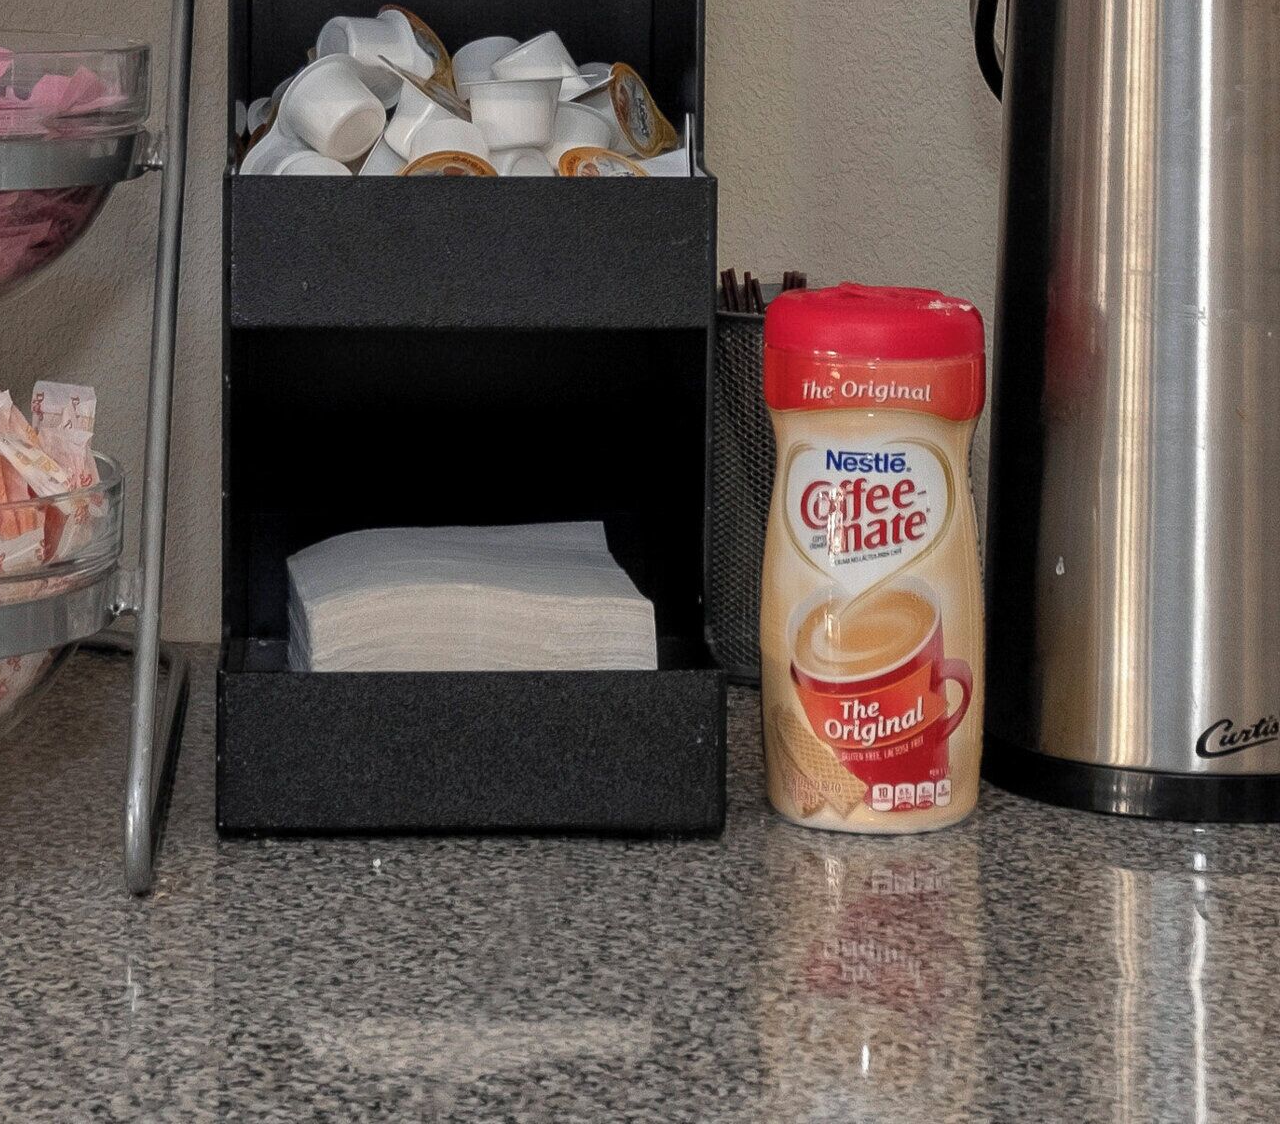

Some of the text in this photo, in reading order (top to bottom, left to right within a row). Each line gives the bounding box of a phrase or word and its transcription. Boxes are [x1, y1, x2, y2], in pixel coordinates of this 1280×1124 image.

[801, 378, 932, 404] The Original
[824, 694, 925, 747] Original
[839, 698, 880, 721] The
[1195, 713, 1280, 760] Curtis
